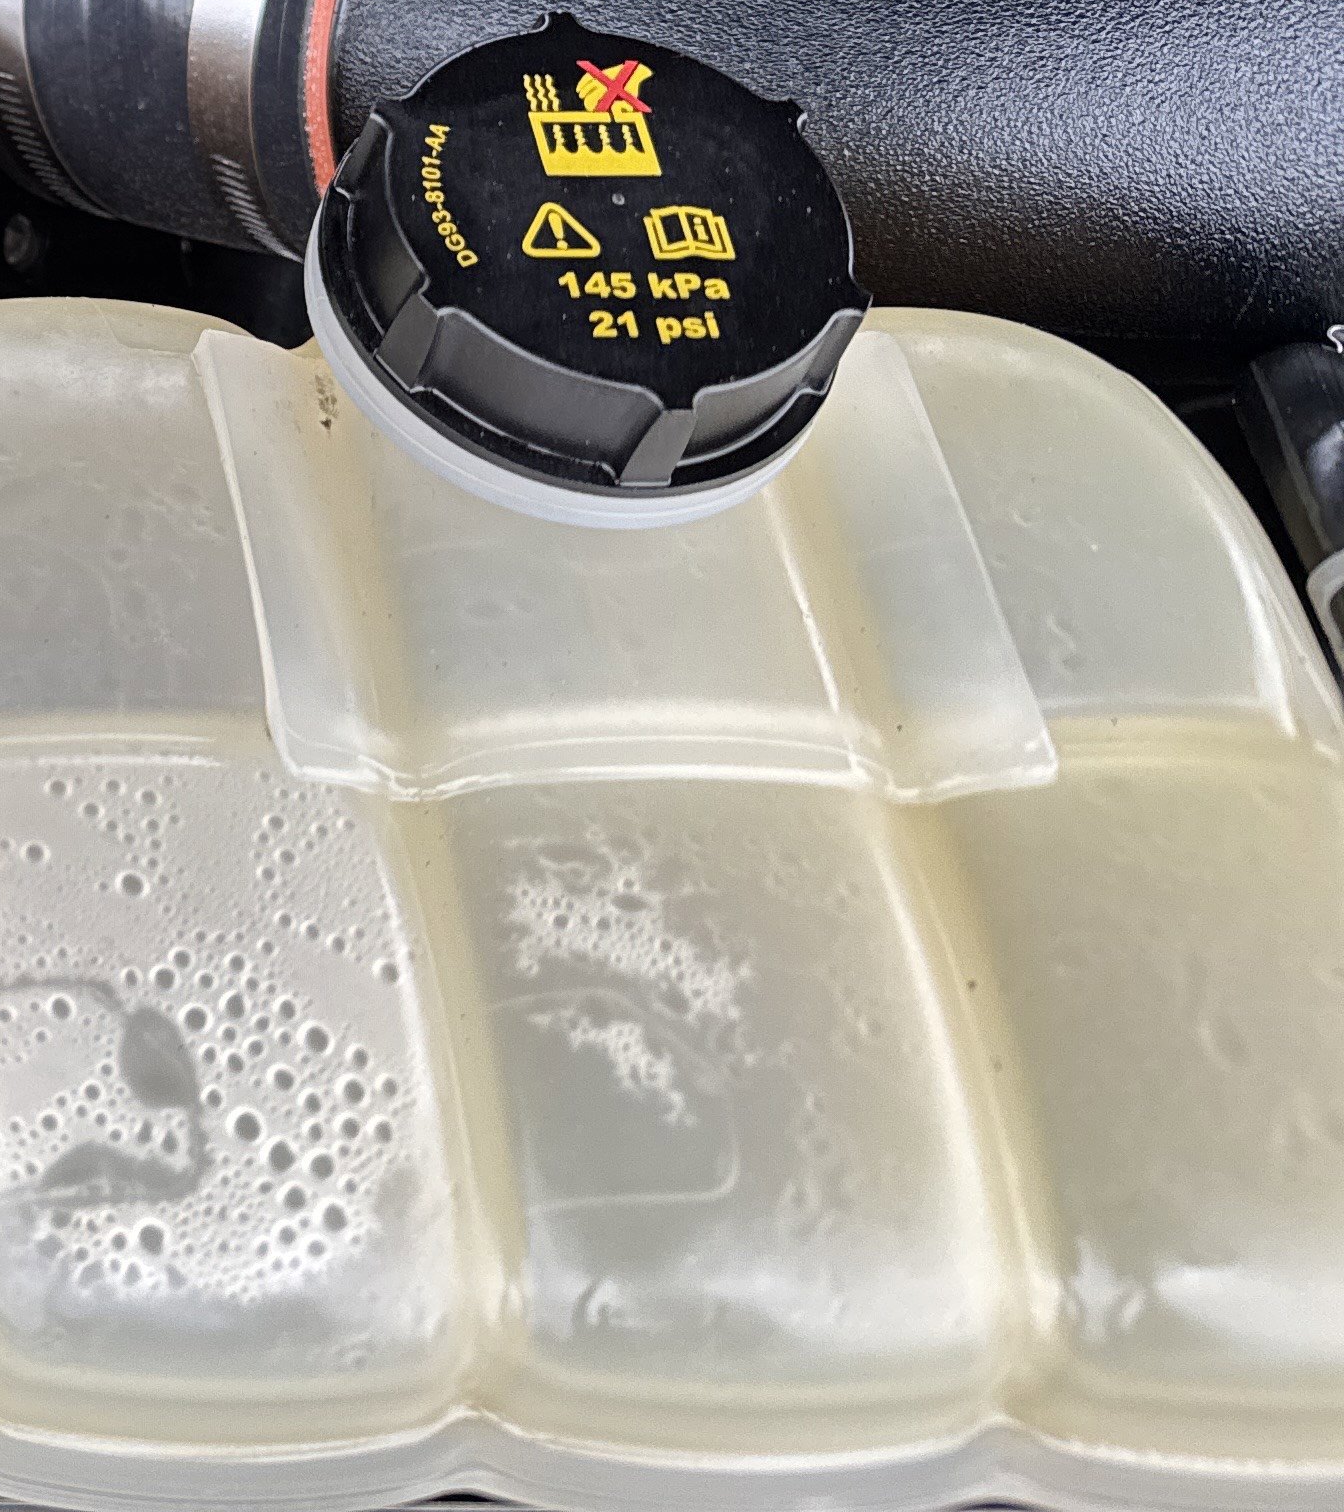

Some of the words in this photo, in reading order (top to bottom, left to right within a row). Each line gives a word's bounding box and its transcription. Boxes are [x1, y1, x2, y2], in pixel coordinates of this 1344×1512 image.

[421, 124, 479, 268] DG93-8101-AA
[558, 271, 636, 299] 145
[647, 271, 730, 300] kPa
[589, 309, 639, 339] 21
[655, 311, 720, 345] psi
